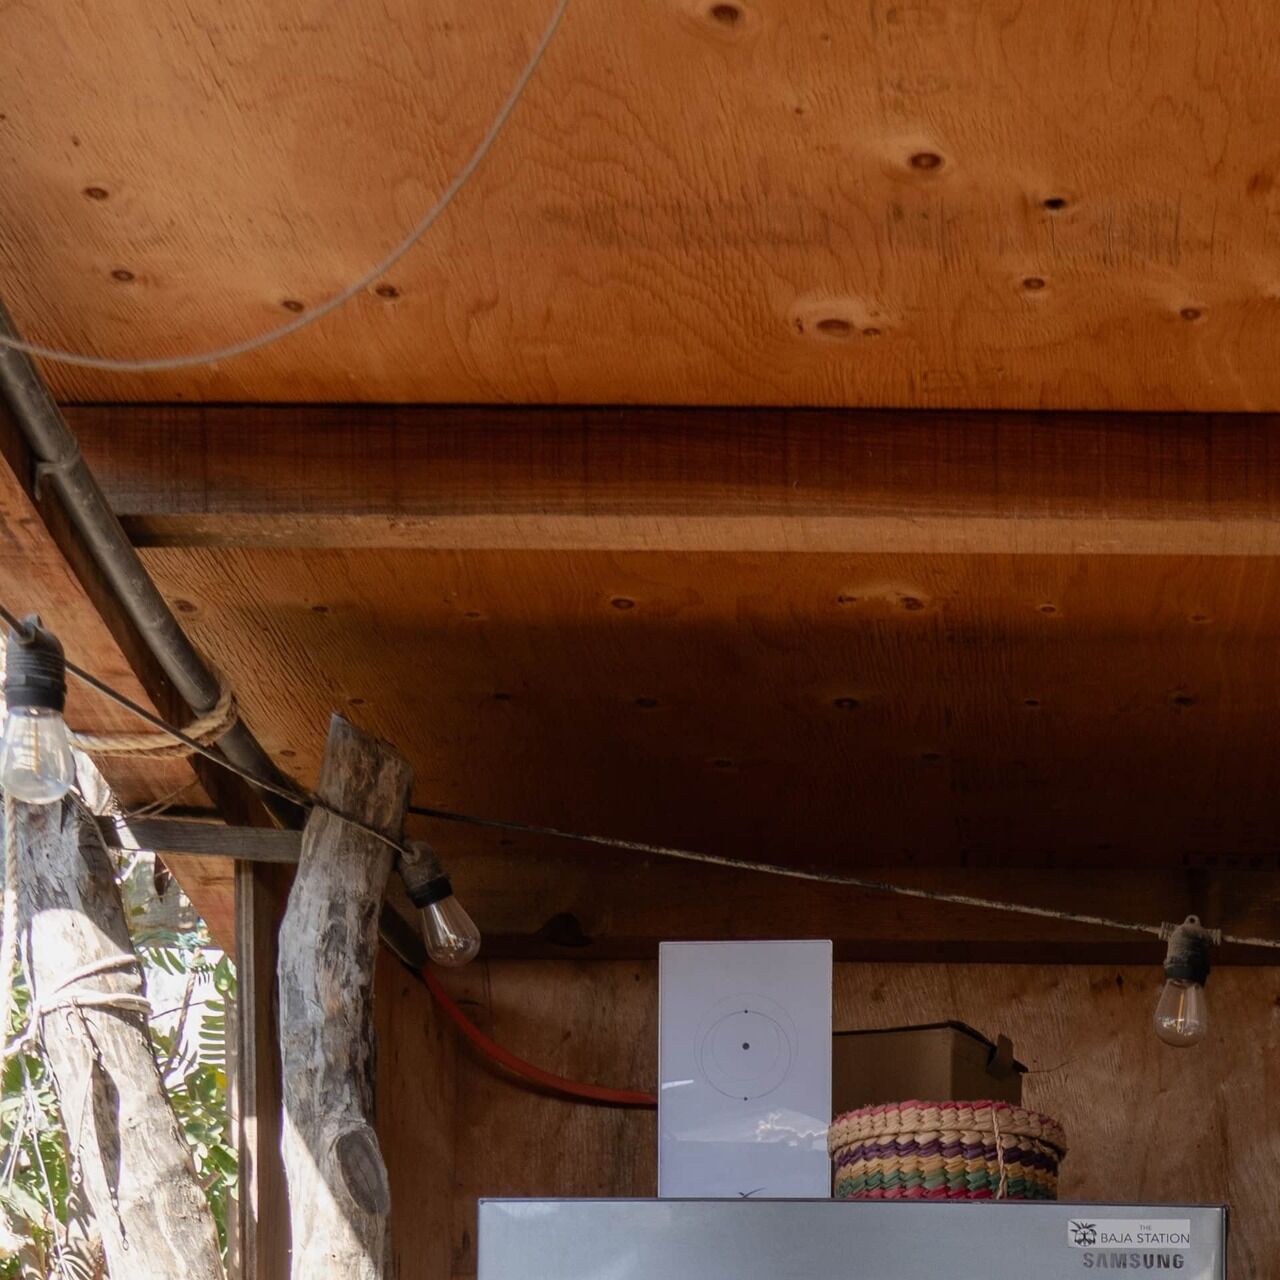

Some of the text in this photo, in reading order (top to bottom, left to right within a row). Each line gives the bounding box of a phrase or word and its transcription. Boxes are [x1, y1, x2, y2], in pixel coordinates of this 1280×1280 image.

[1100, 1233, 1190, 1243] BAJA STATION
[1083, 1252, 1184, 1269] SAMSUNG
